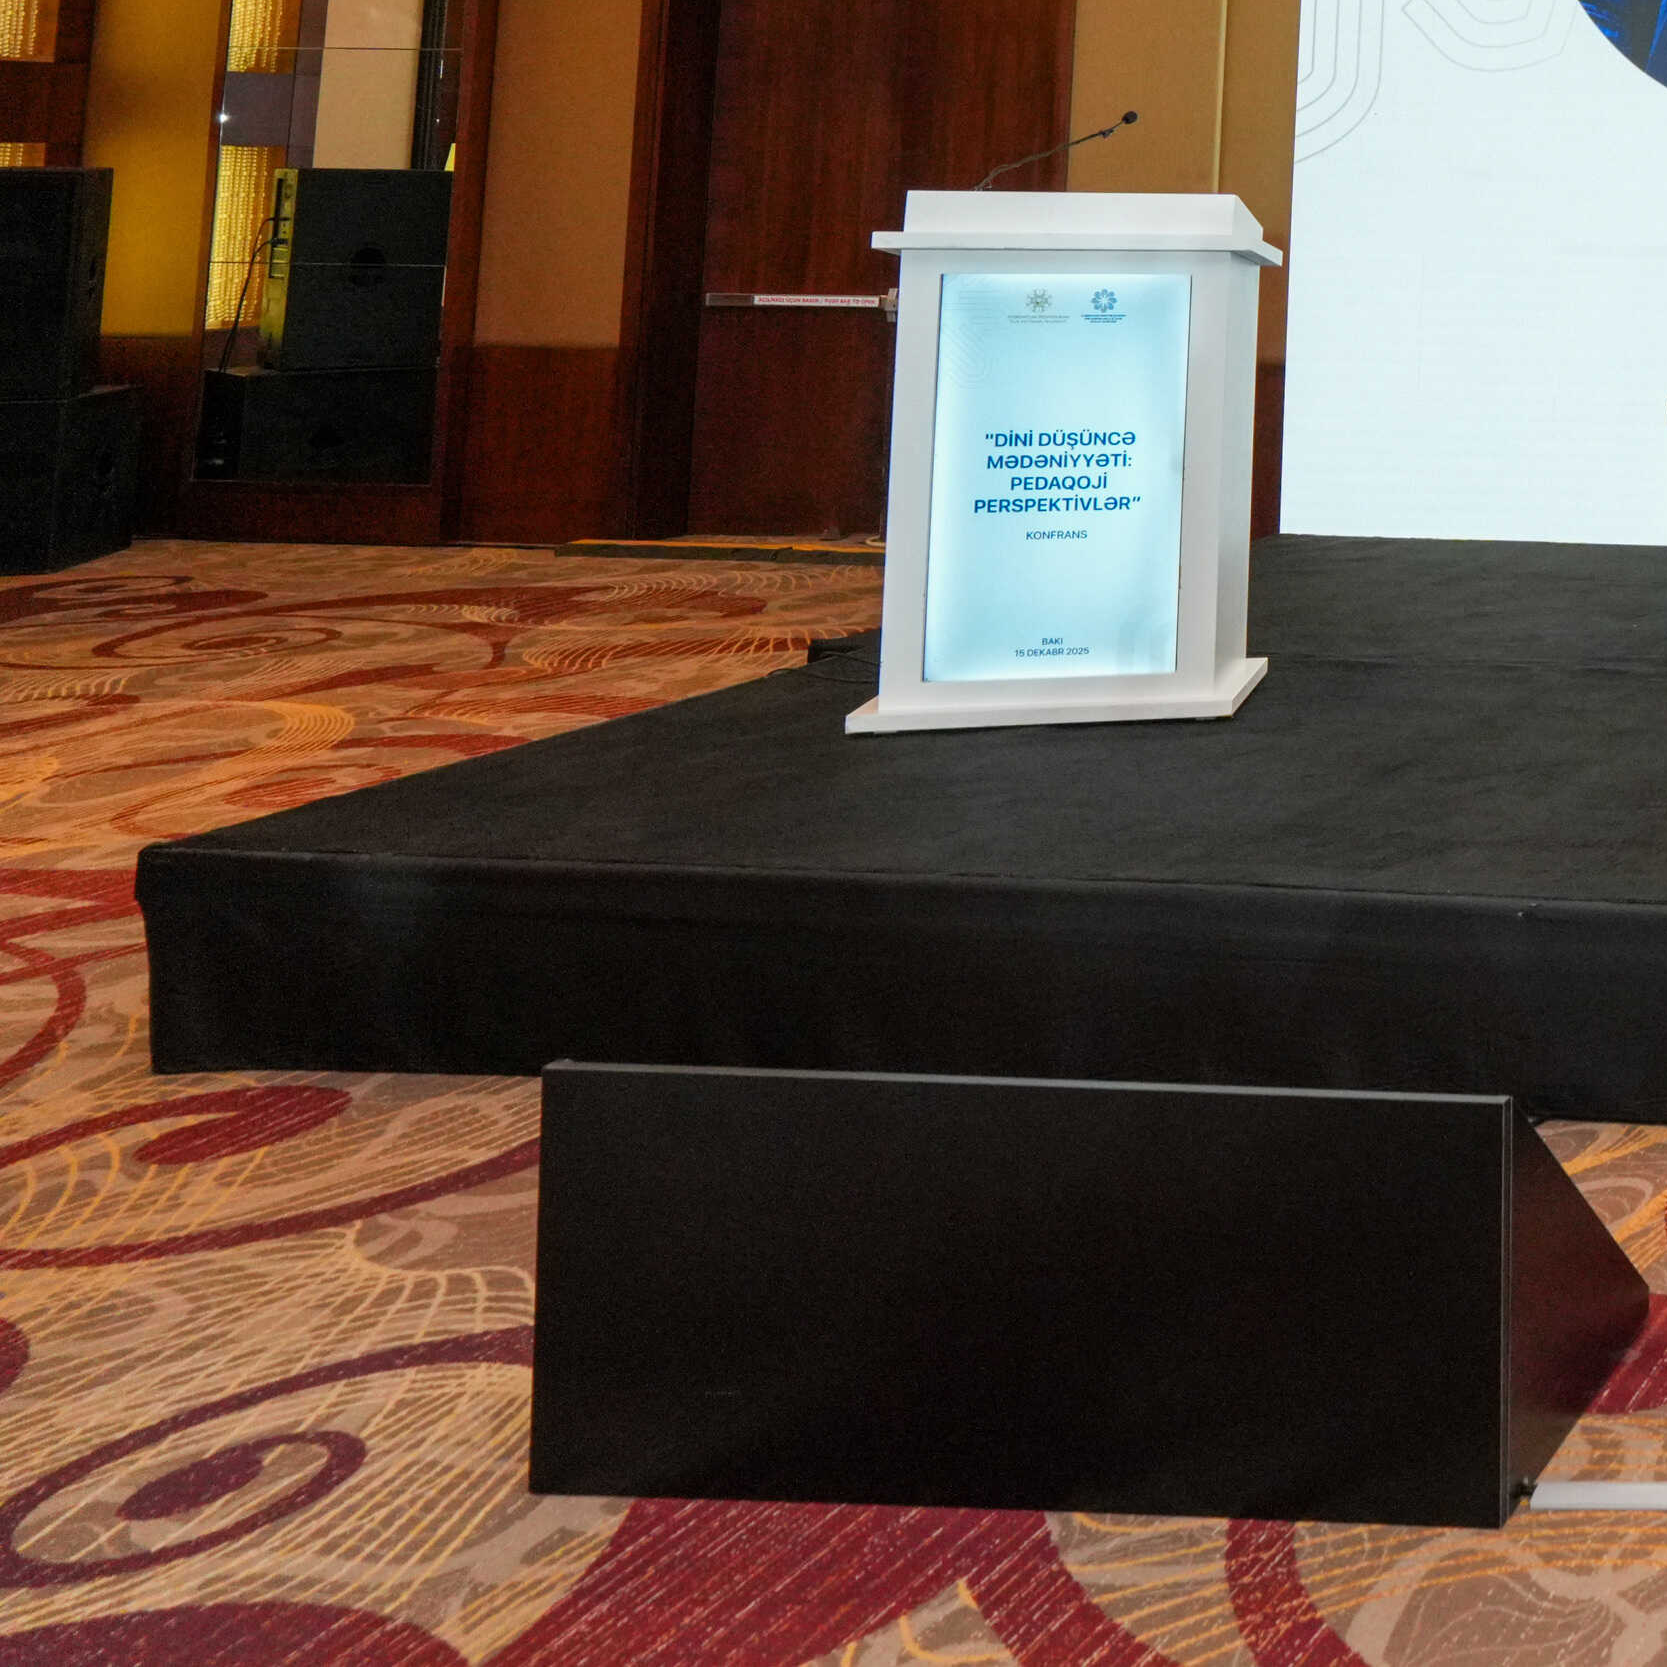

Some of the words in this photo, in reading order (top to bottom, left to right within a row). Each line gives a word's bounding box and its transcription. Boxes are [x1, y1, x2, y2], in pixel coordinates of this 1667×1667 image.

[1038, 429, 1136, 451] DÜŞÜNCƏ
[986, 450, 1133, 469] MƏDƏNİYYƏTİ:
[1010, 472, 1108, 491] PEDAQOJİ
[1025, 530, 1088, 541] KONFRANS
[1041, 637, 1064, 646] BAKI
[1026, 647, 1065, 657] DEKABR
[1065, 646, 1090, 656] 2025
